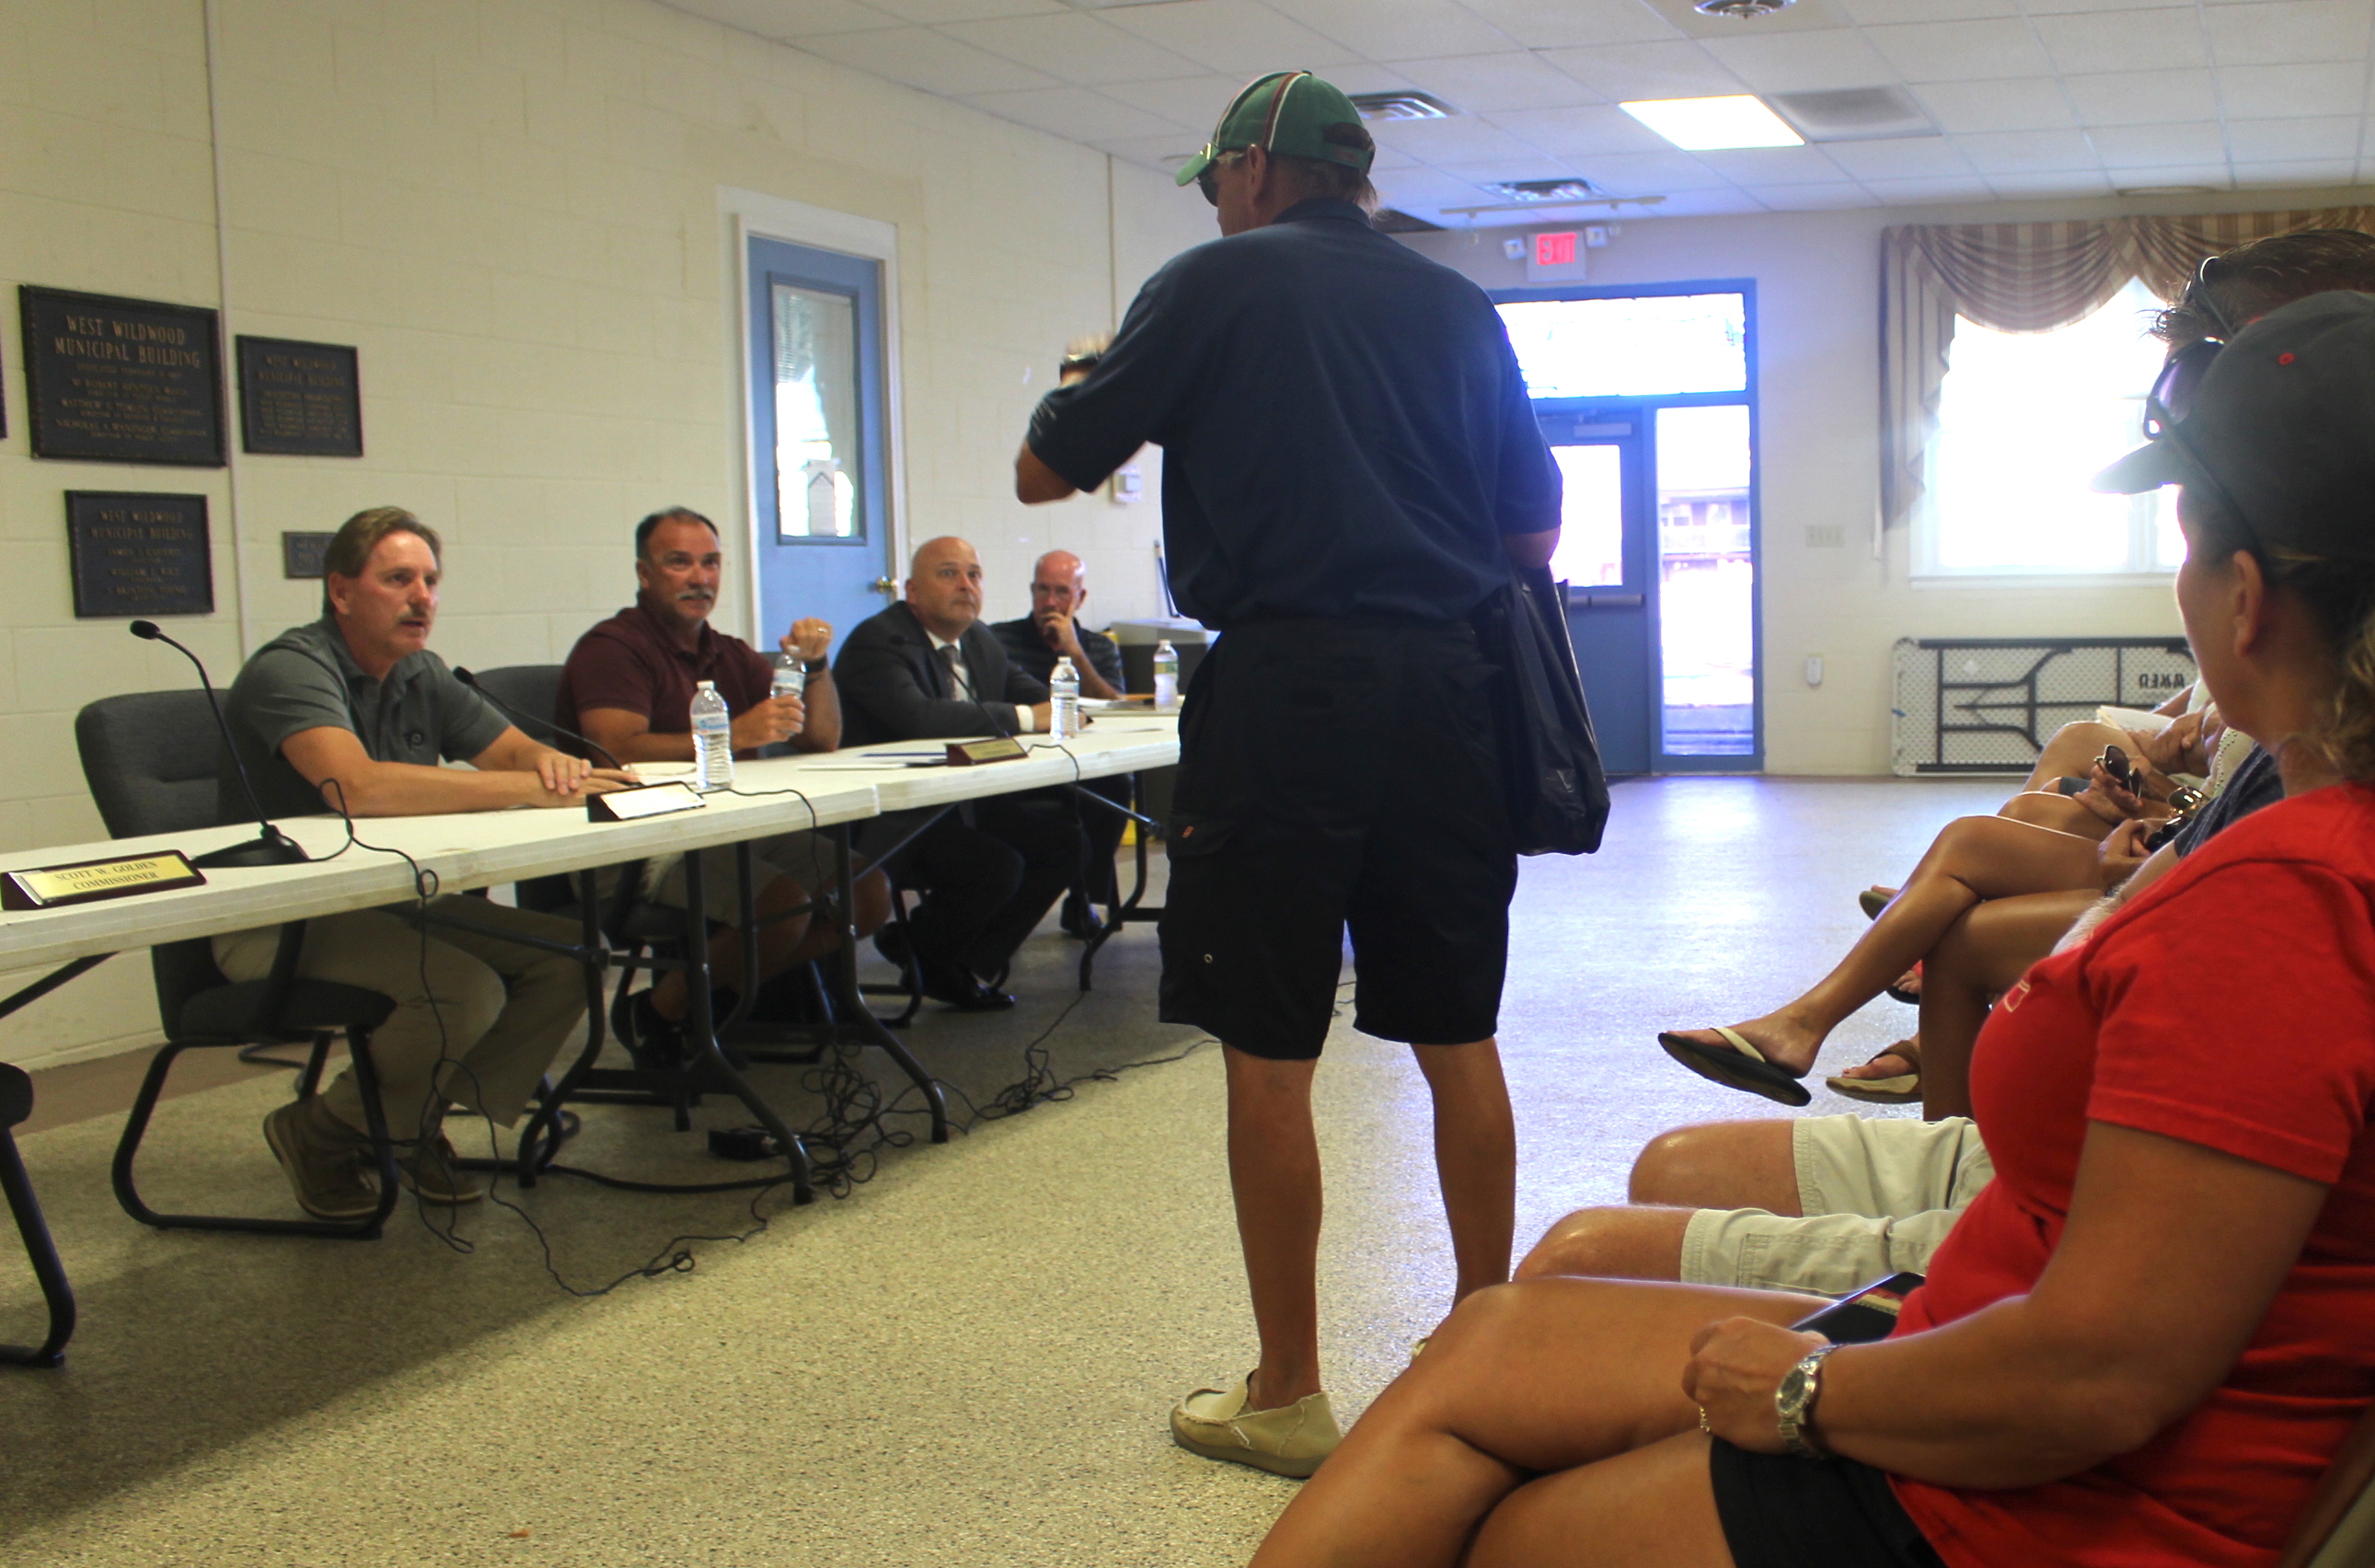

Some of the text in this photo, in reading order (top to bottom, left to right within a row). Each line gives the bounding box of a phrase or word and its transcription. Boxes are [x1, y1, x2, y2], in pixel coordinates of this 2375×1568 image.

[66, 314, 186, 346] WEST WILDWOOD
[54, 337, 201, 369] MUNICIPAL BUILDING
[100, 510, 183, 524] WEST WILDWOOD
[91, 526, 194, 541] MUNICIPAL BUILDING
[55, 870, 93, 881] SCOTT
[112, 860, 158, 873] GOLDEN
[73, 871, 159, 890] COMMISSIONER
